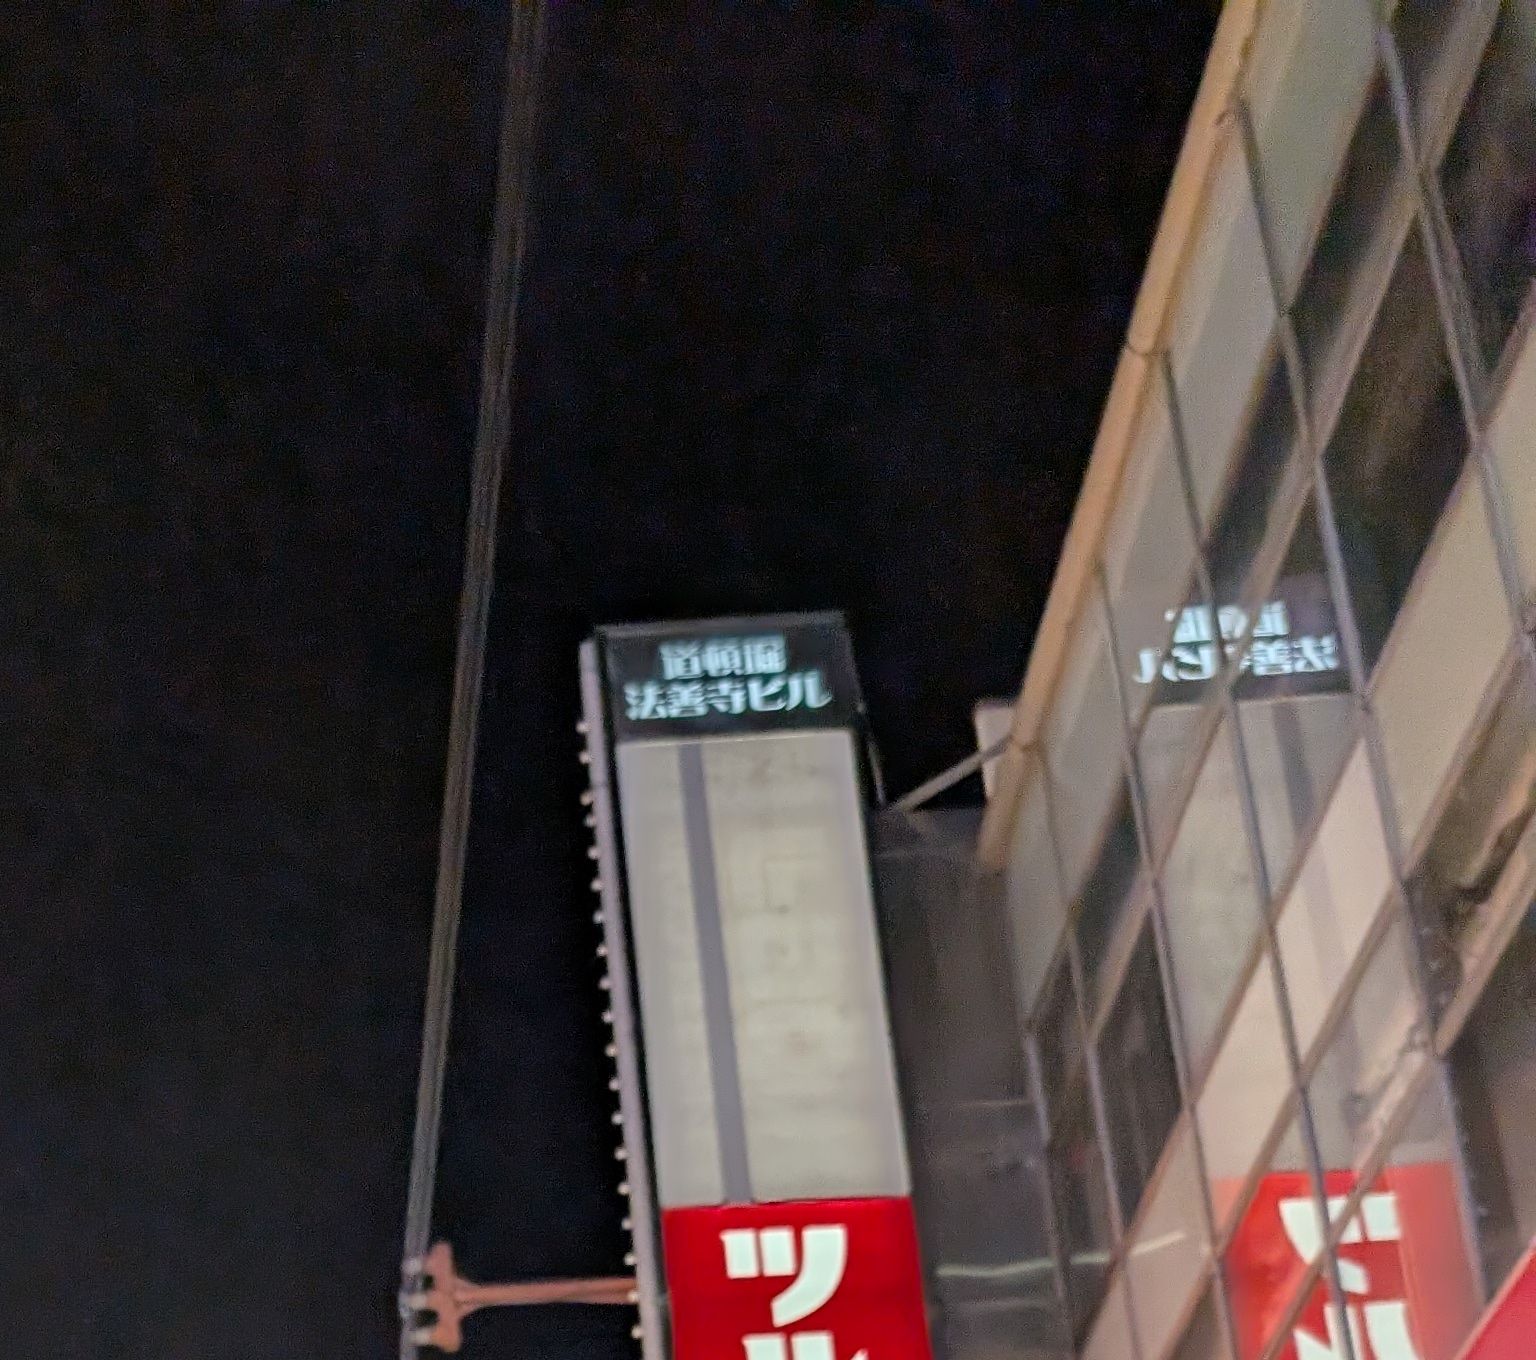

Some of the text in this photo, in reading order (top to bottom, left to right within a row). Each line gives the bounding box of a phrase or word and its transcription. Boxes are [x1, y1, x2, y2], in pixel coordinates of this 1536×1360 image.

[624, 668, 833, 721] 法善寺ビル
